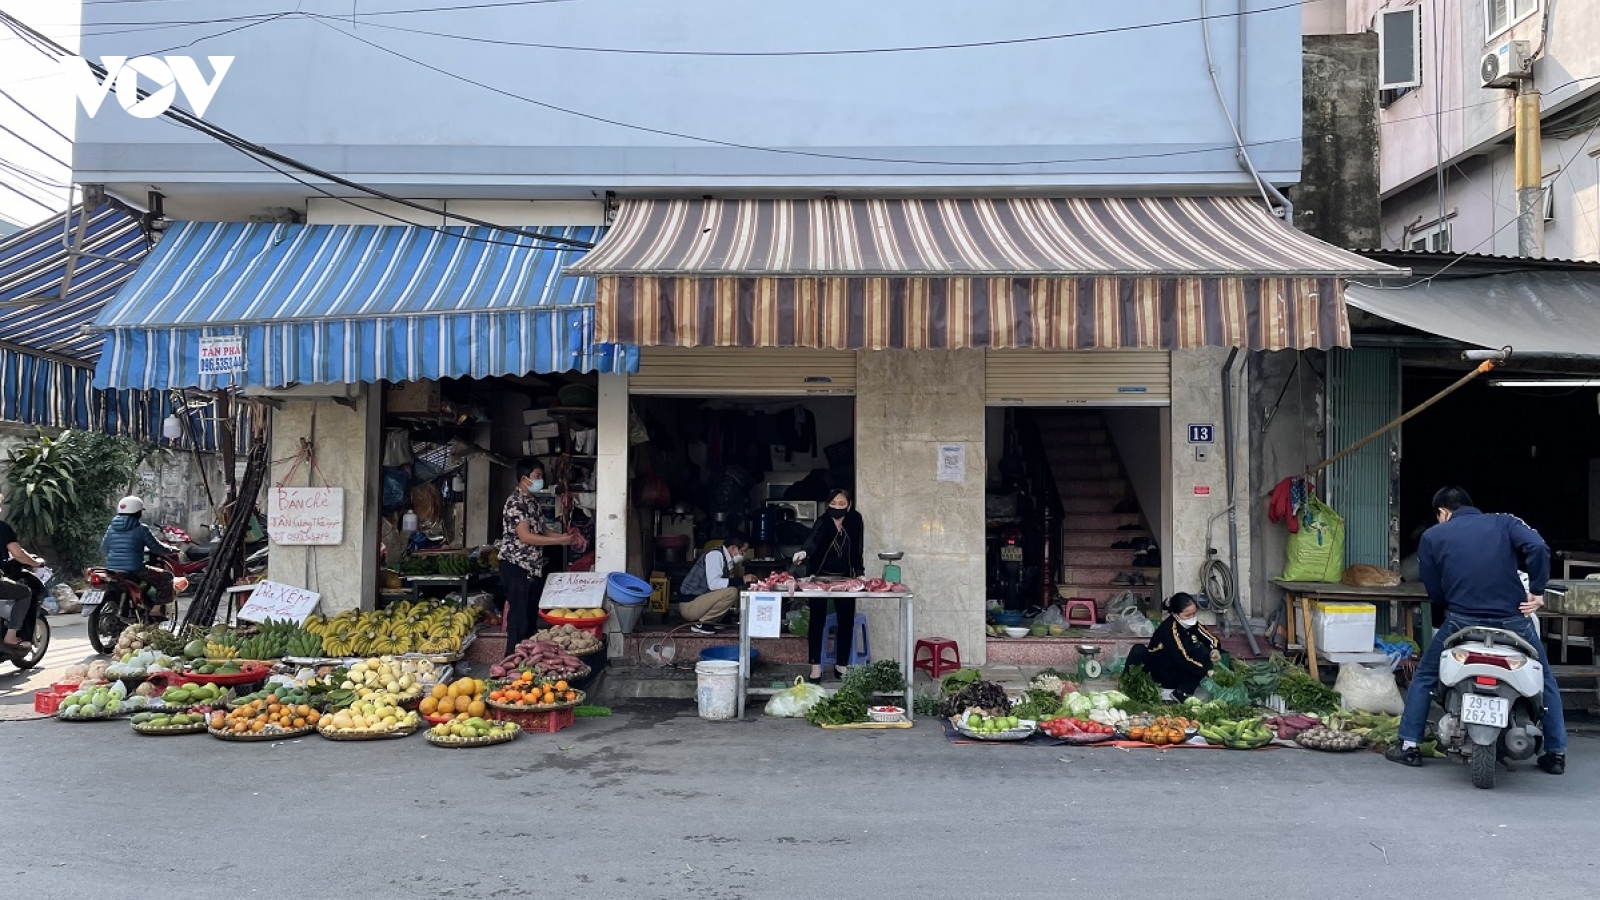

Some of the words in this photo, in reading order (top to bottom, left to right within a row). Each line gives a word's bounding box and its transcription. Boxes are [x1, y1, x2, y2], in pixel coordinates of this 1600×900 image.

[1193, 427, 1209, 440] 13
[1469, 696, 1502, 712] 29-C1
[1464, 708, 1504, 726] 262.51
